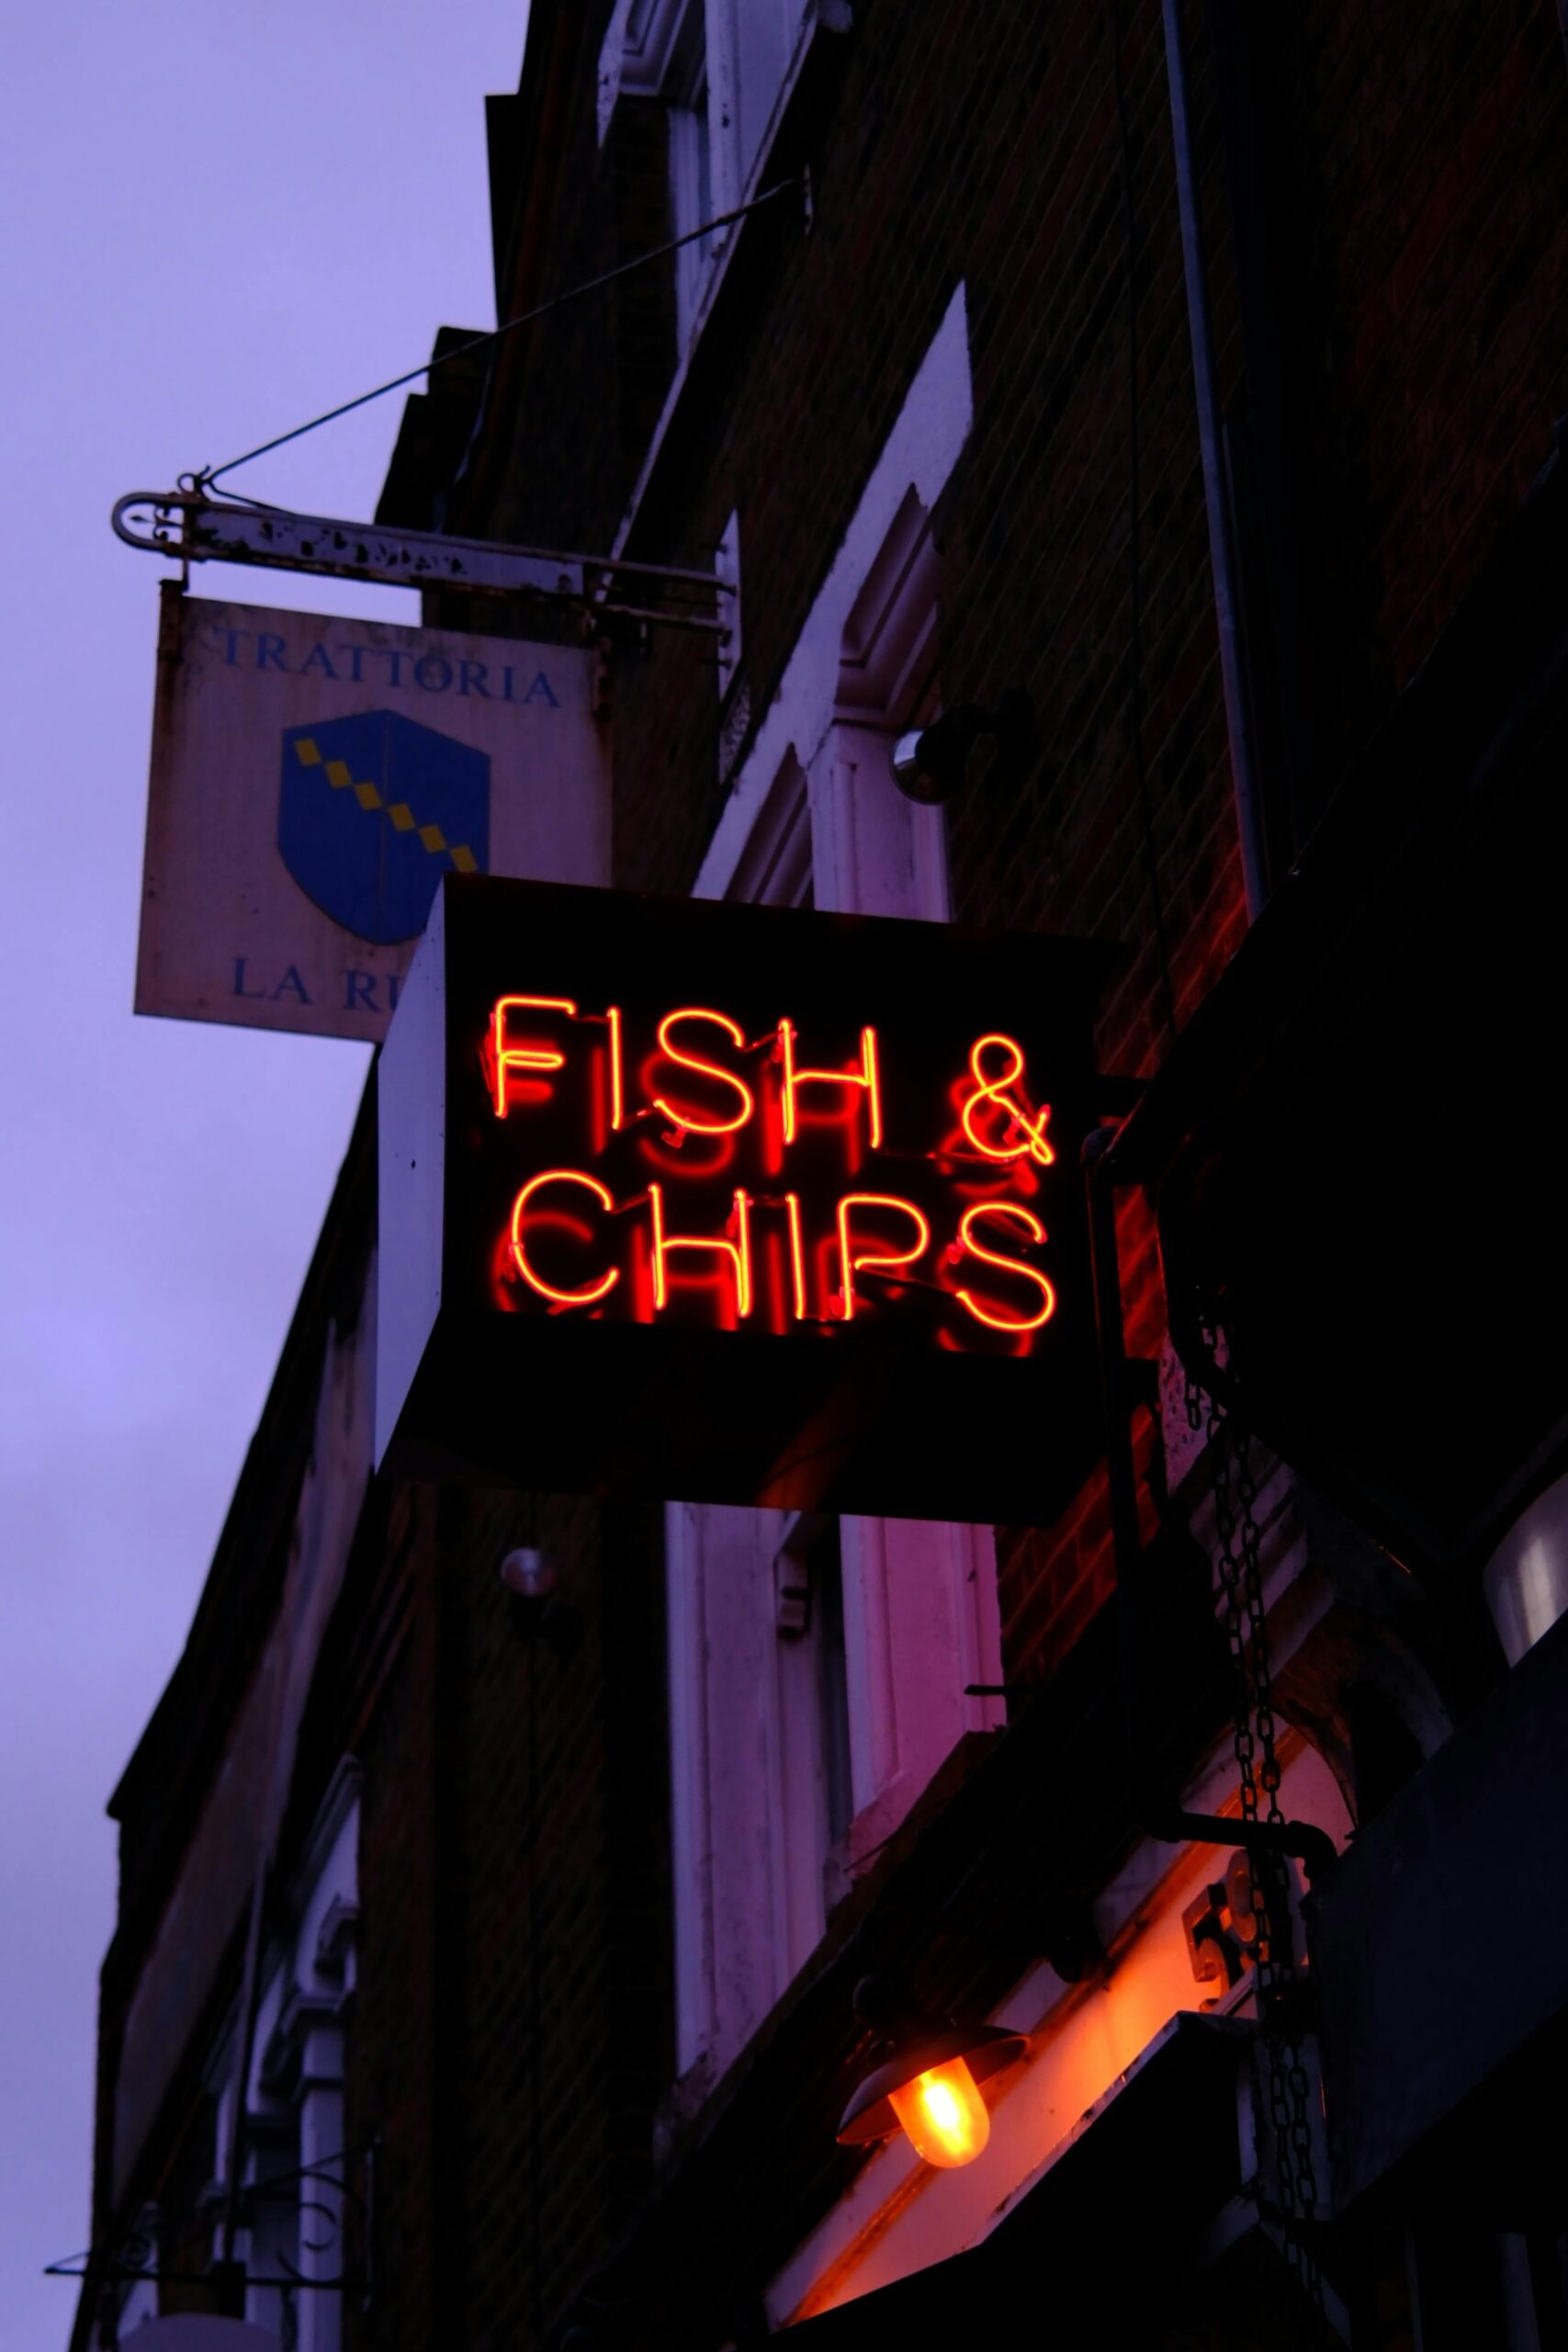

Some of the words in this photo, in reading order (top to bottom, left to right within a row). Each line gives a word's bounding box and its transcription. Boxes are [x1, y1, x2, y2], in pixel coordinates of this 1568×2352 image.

[212, 626, 559, 707] TRATTORIA
[232, 956, 313, 1005] LA
[492, 993, 884, 1150] FISH
[961, 1034, 1056, 1167] &
[510, 1169, 1057, 1332] CHIPS
